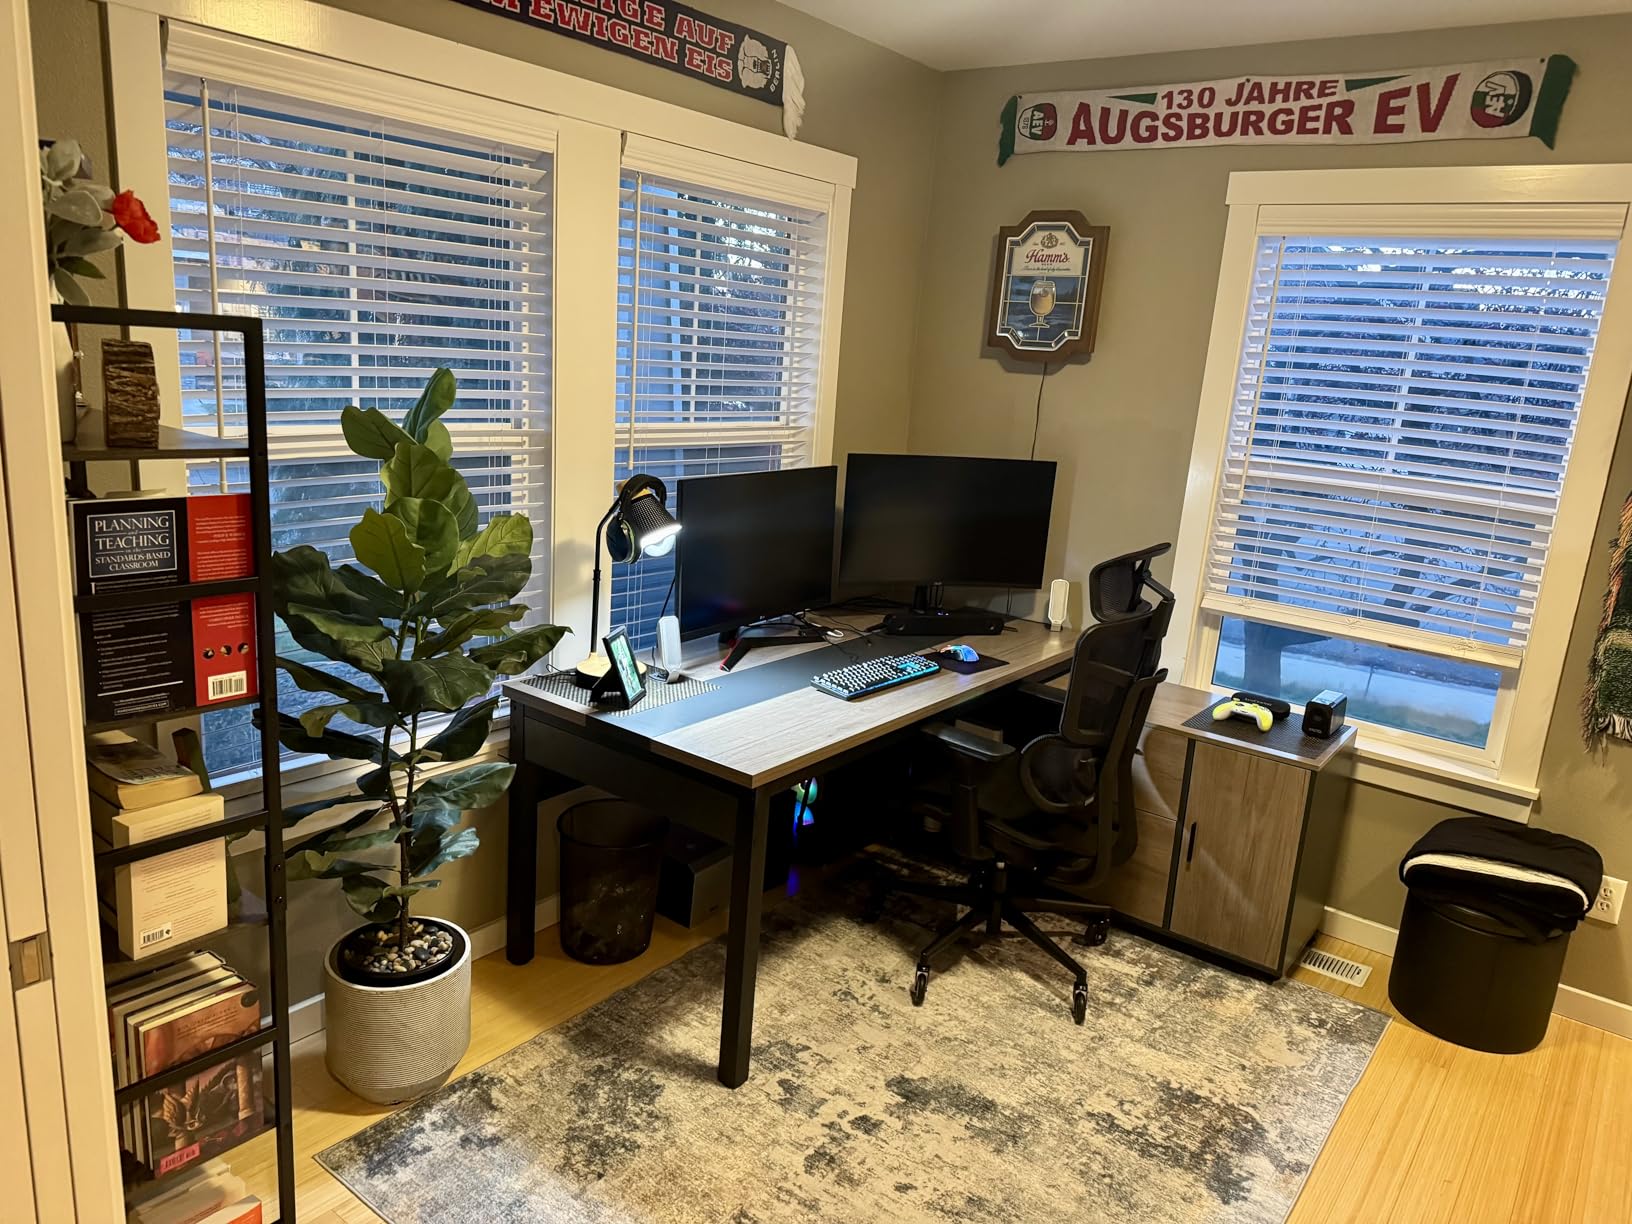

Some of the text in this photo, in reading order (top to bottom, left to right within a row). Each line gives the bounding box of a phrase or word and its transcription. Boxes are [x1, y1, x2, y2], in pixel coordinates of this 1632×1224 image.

[528, 0, 734, 82] EWIGEN EIS
[674, 14, 735, 53] AUF
[1161, 80, 1339, 110] 130 JAHRE
[1485, 81, 1508, 117] AEV
[1066, 72, 1461, 146] AUGSBURGER EV
[1030, 110, 1043, 136] AEV
[1025, 248, 1070, 264] Hamm's
[95, 515, 169, 532] PLANNING
[95, 533, 169, 550] TEACHING
[95, 551, 171, 565] STANDARDS-BASED
[109, 560, 159, 572] CLASSROOM
